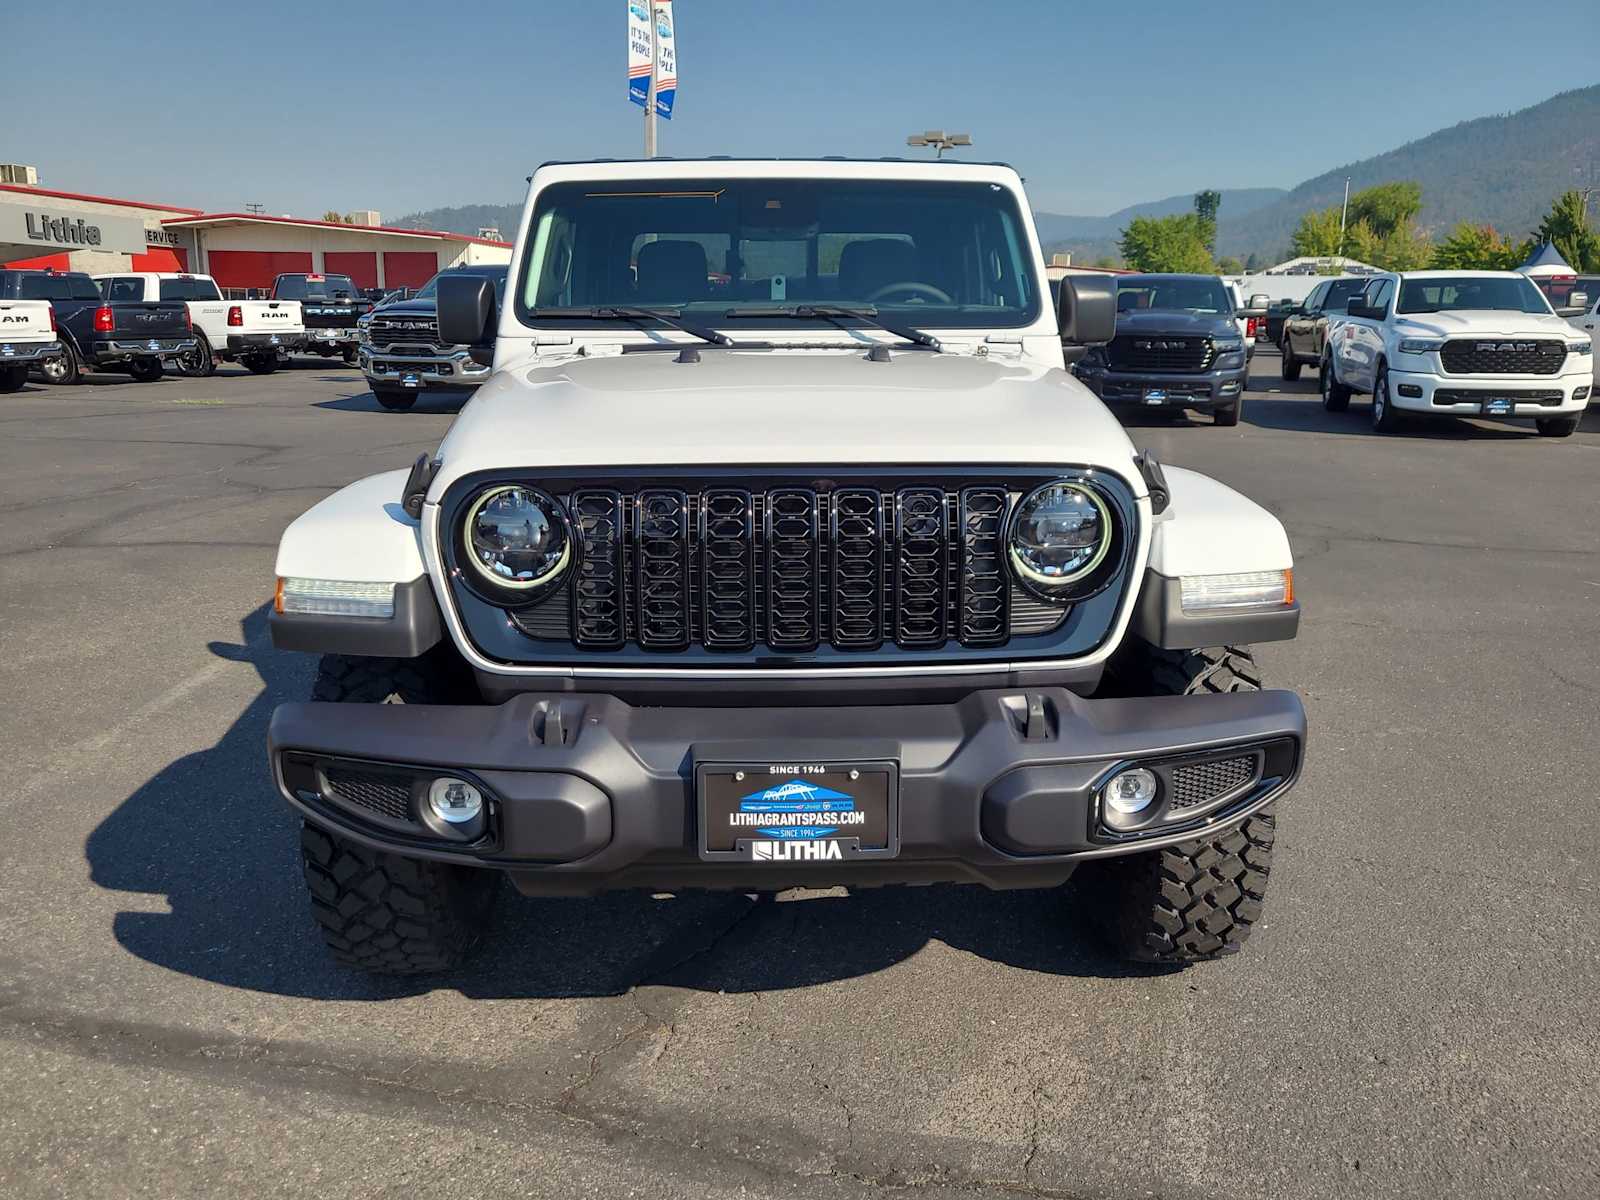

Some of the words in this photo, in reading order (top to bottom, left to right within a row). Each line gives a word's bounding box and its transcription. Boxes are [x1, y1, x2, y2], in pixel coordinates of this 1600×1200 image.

[632, 41, 650, 58] PEOPLE
[25, 212, 102, 246] Lithia
[305, 308, 352, 316] RAM
[386, 321, 430, 330] RAM
[1135, 341, 1186, 350] RAM
[1476, 343, 1537, 352] RAM
[769, 766, 800, 774] SINCE
[802, 765, 826, 774] 1946
[729, 811, 865, 826] LITHIAGRANTSPASS.COM
[780, 829, 798, 838] SINCE
[773, 840, 843, 860] LITHIA
